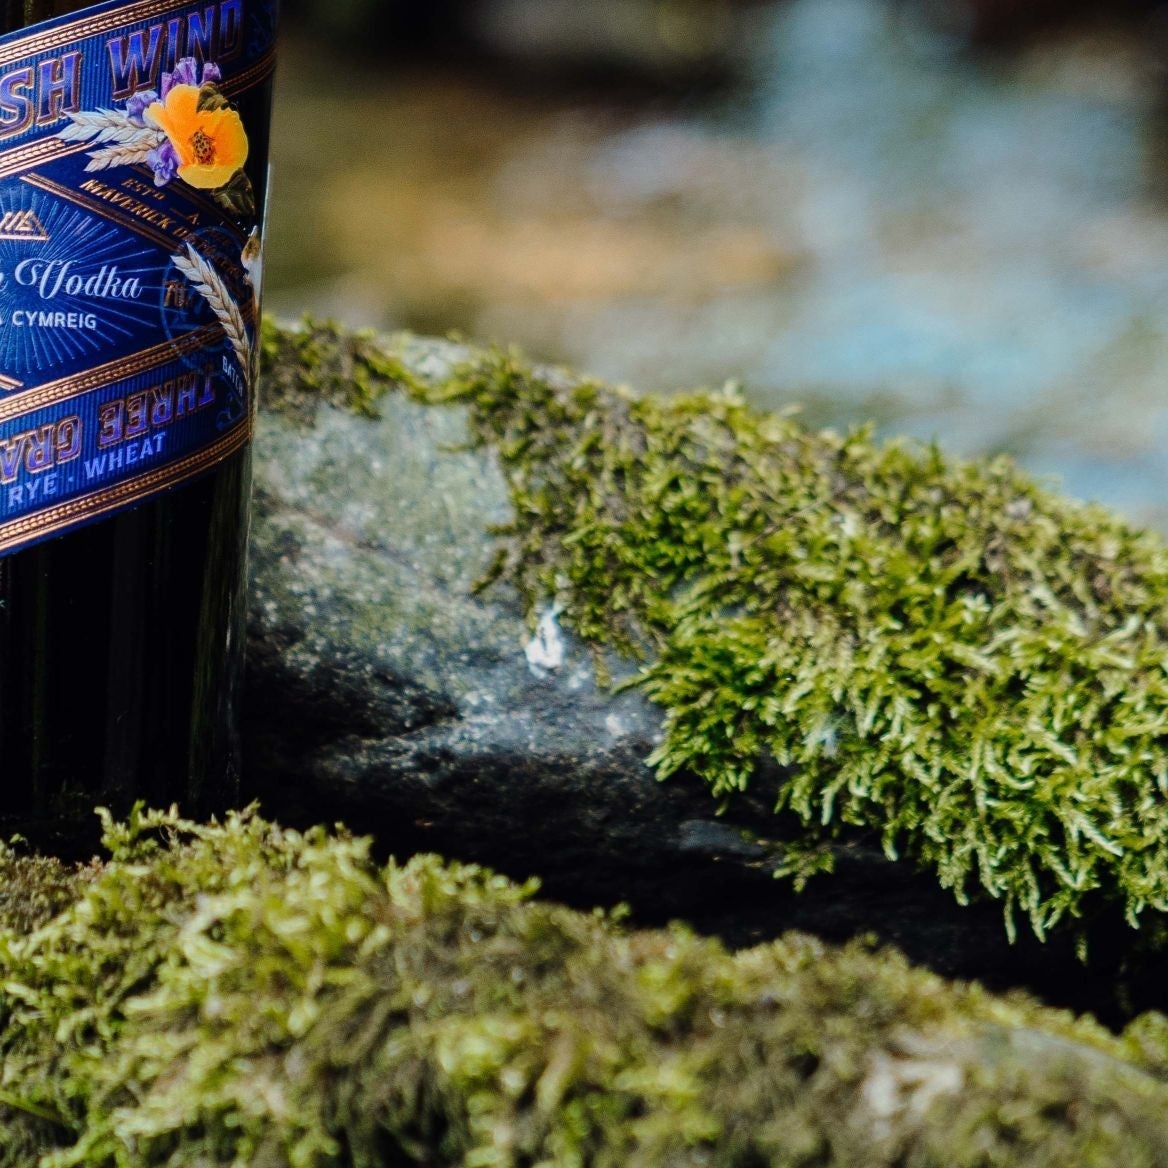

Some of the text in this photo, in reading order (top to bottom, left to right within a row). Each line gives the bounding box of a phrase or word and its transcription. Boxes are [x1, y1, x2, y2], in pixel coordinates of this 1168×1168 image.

[79, 178, 177, 231] MAVERICK
[14, 257, 144, 300] Vodka
[11, 310, 98, 331] CYMREIG
[222, 355, 244, 397] BATCH
[96, 369, 216, 449] THREE
[8, 472, 58, 508] RYE
[83, 431, 167, 480] WHEAT
